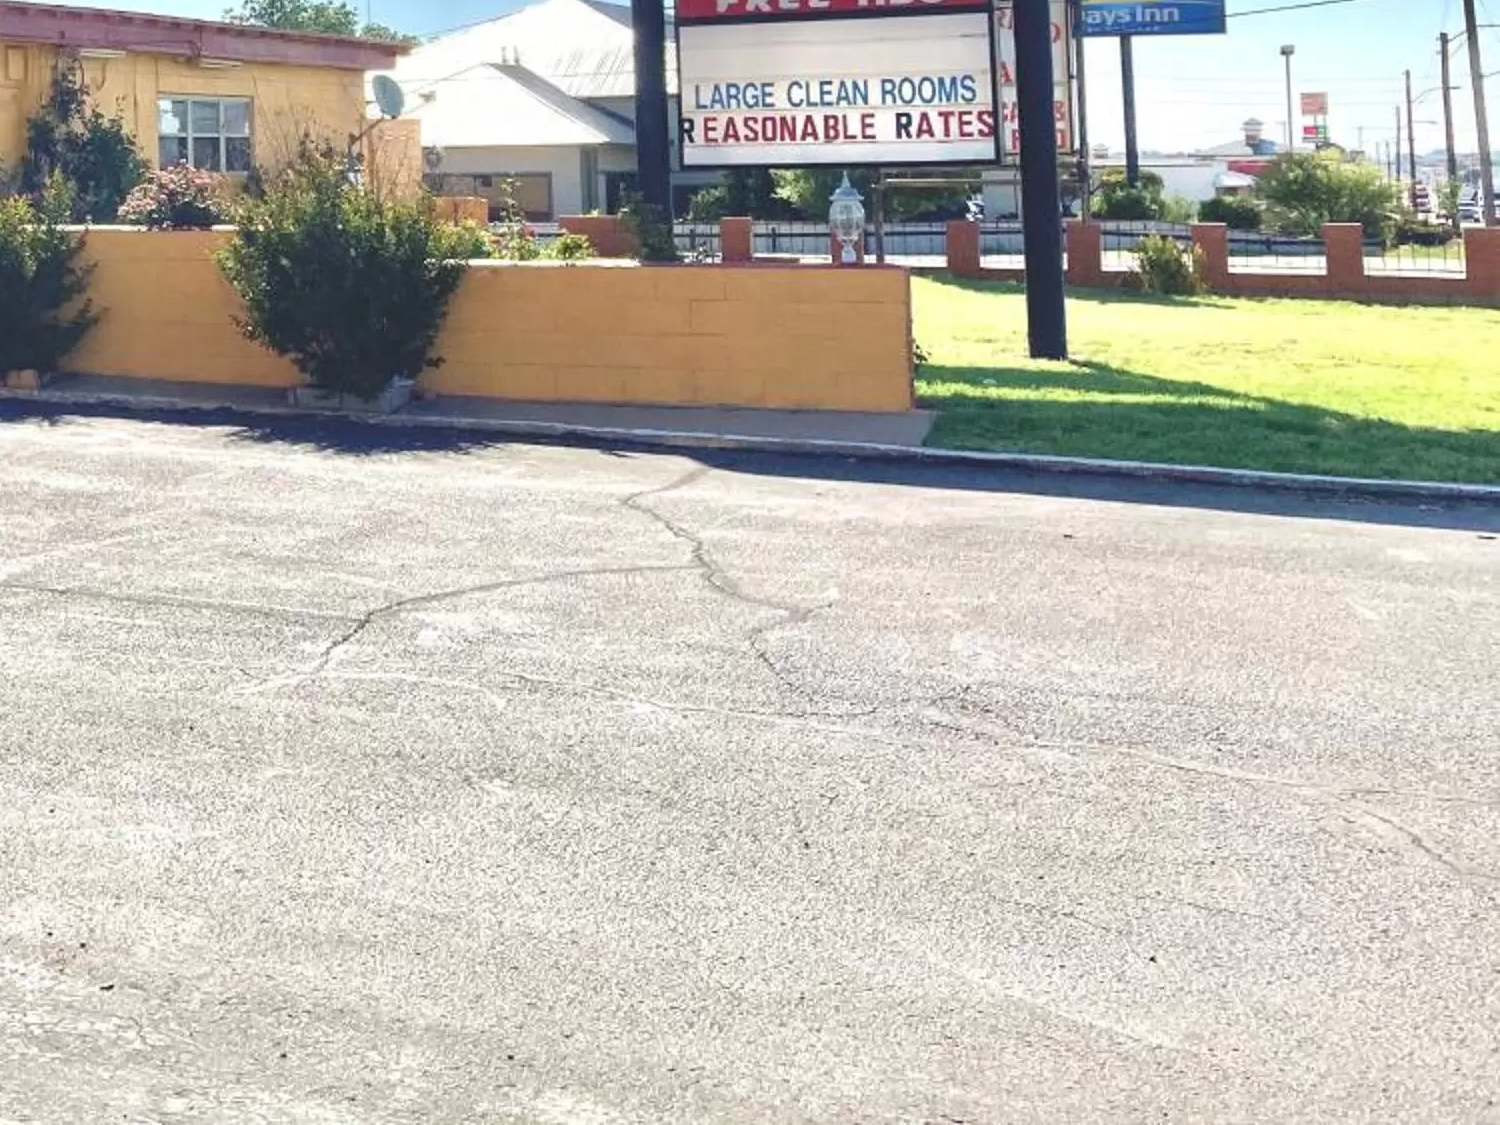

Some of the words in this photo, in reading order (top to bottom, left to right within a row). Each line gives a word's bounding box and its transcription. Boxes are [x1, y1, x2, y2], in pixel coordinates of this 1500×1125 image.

[1082, 6, 1131, 26] ays
[1135, 4, 1179, 23] Inn
[695, 82, 776, 110] LARGE
[786, 78, 869, 108] CLEAN
[881, 75, 977, 105] ROOMS
[895, 110, 994, 140] RATES
